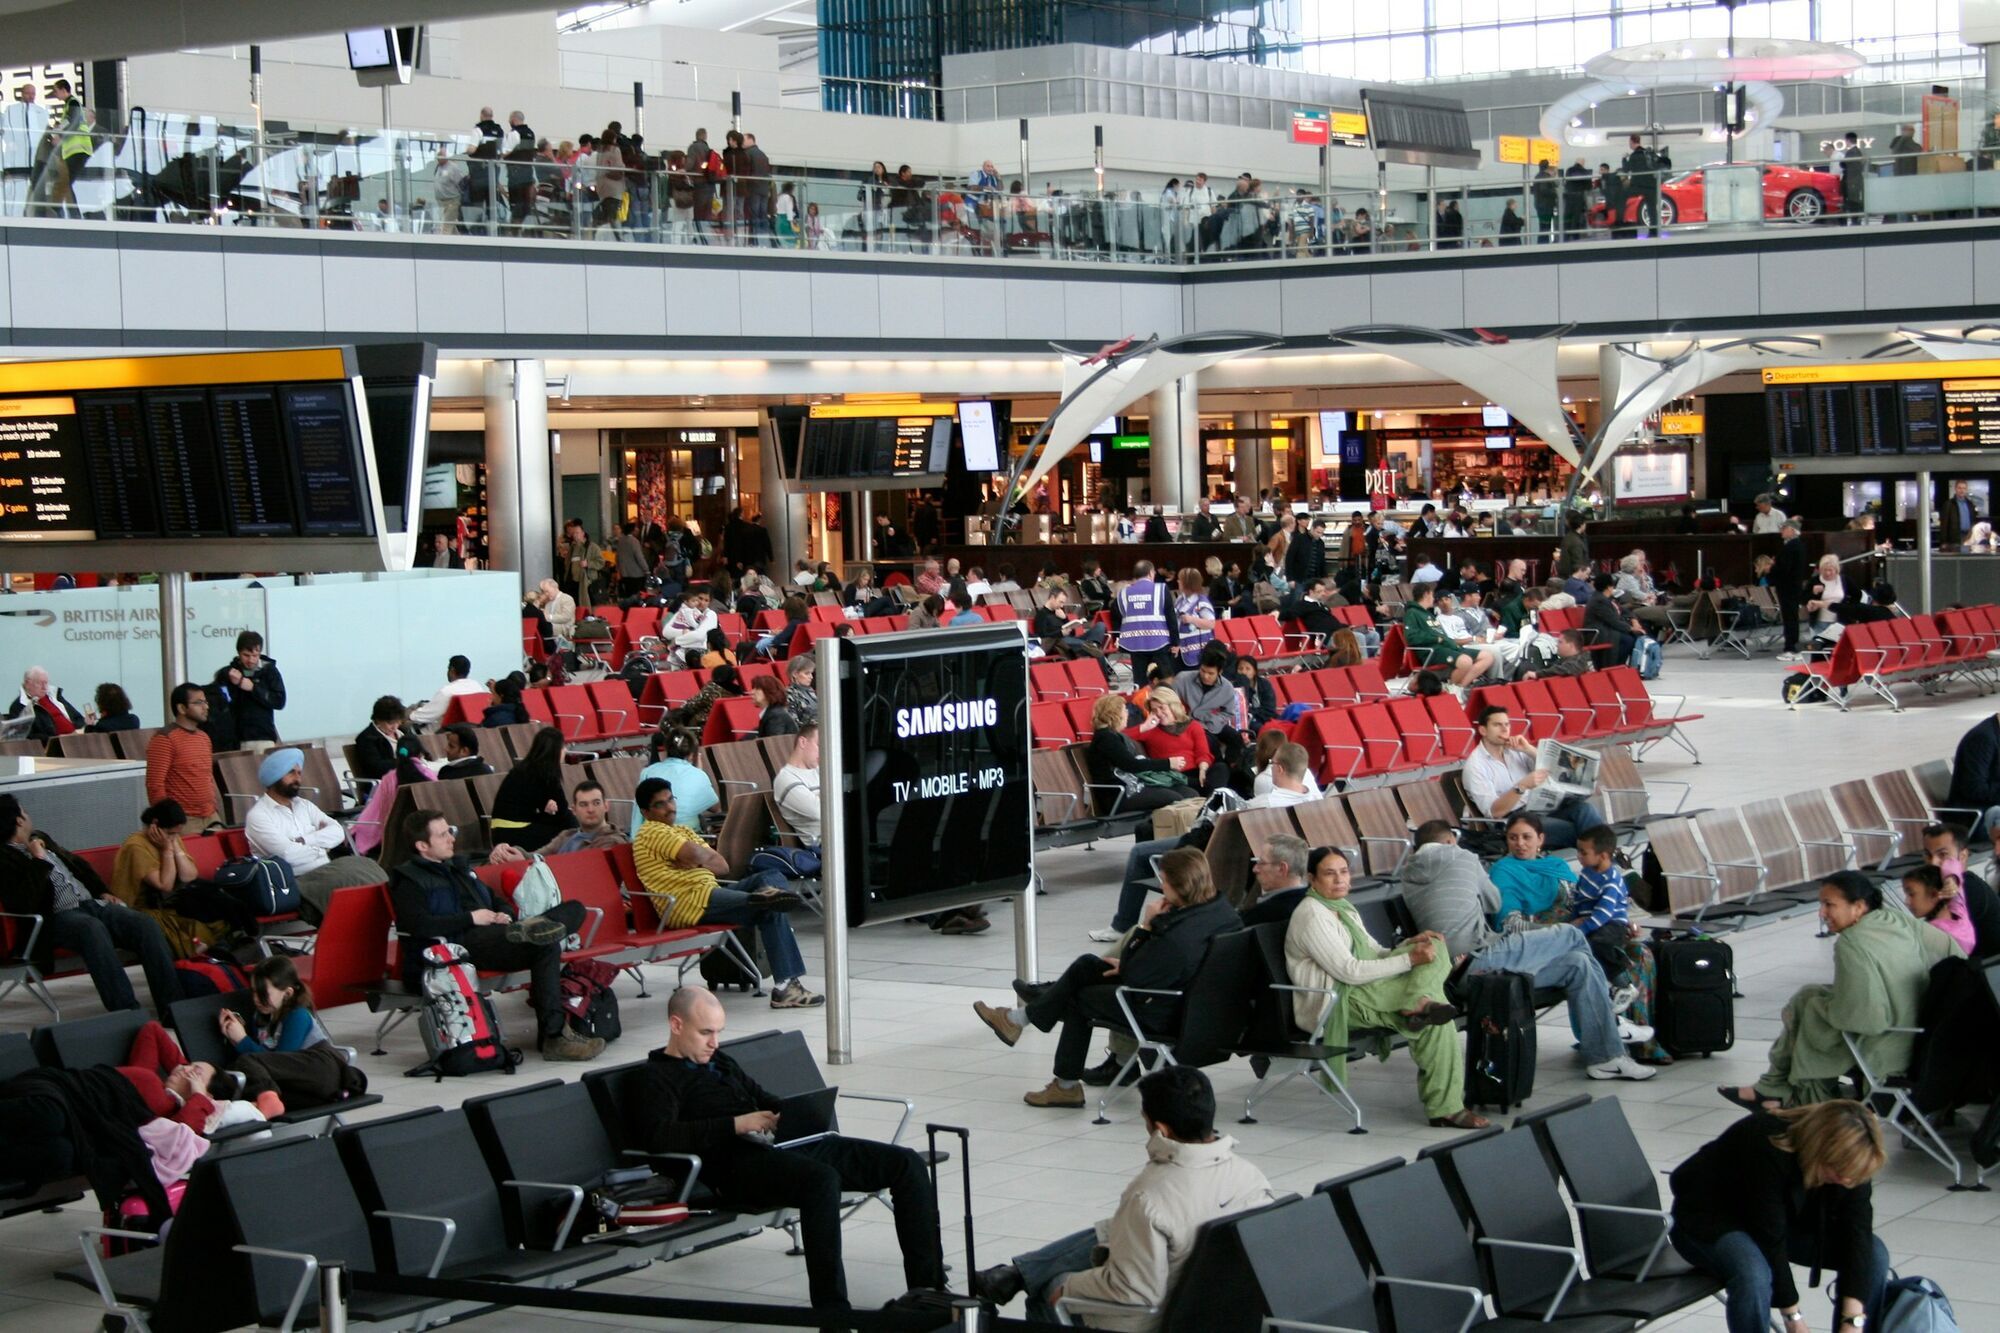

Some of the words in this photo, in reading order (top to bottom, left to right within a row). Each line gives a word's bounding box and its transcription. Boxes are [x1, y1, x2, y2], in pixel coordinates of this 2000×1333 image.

[1775, 372, 1818, 380] Departures
[16, 422, 28, 431] the
[28, 422, 59, 432] following
[3, 432, 20, 440] reach
[20, 432, 35, 442] your
[36, 432, 51, 441] gate
[2, 452, 20, 461] gates
[26, 450, 35, 459] 10
[35, 449, 61, 458] minutes
[6, 478, 24, 487] gates
[31, 477, 39, 485] 15
[40, 476, 66, 485] minutes
[1364, 469, 1398, 495] PRET
[5, 504, 11, 512] C
[11, 505, 28, 514] gates
[36, 503, 44, 512] 20
[45, 503, 70, 512] minutes
[1128, 594, 1152, 602] CUSTOMER
[1134, 602, 1146, 610] HOST
[63, 608, 125, 623] BRITISH
[129, 607, 196, 622] AIRS
[64, 628, 129, 642] Customer
[200, 624, 249, 638] Central
[896, 698, 997, 738] SAMSUNG
[892, 781, 910, 803] TV
[921, 772, 968, 798] MOBILE
[978, 767, 1004, 790] MP3
